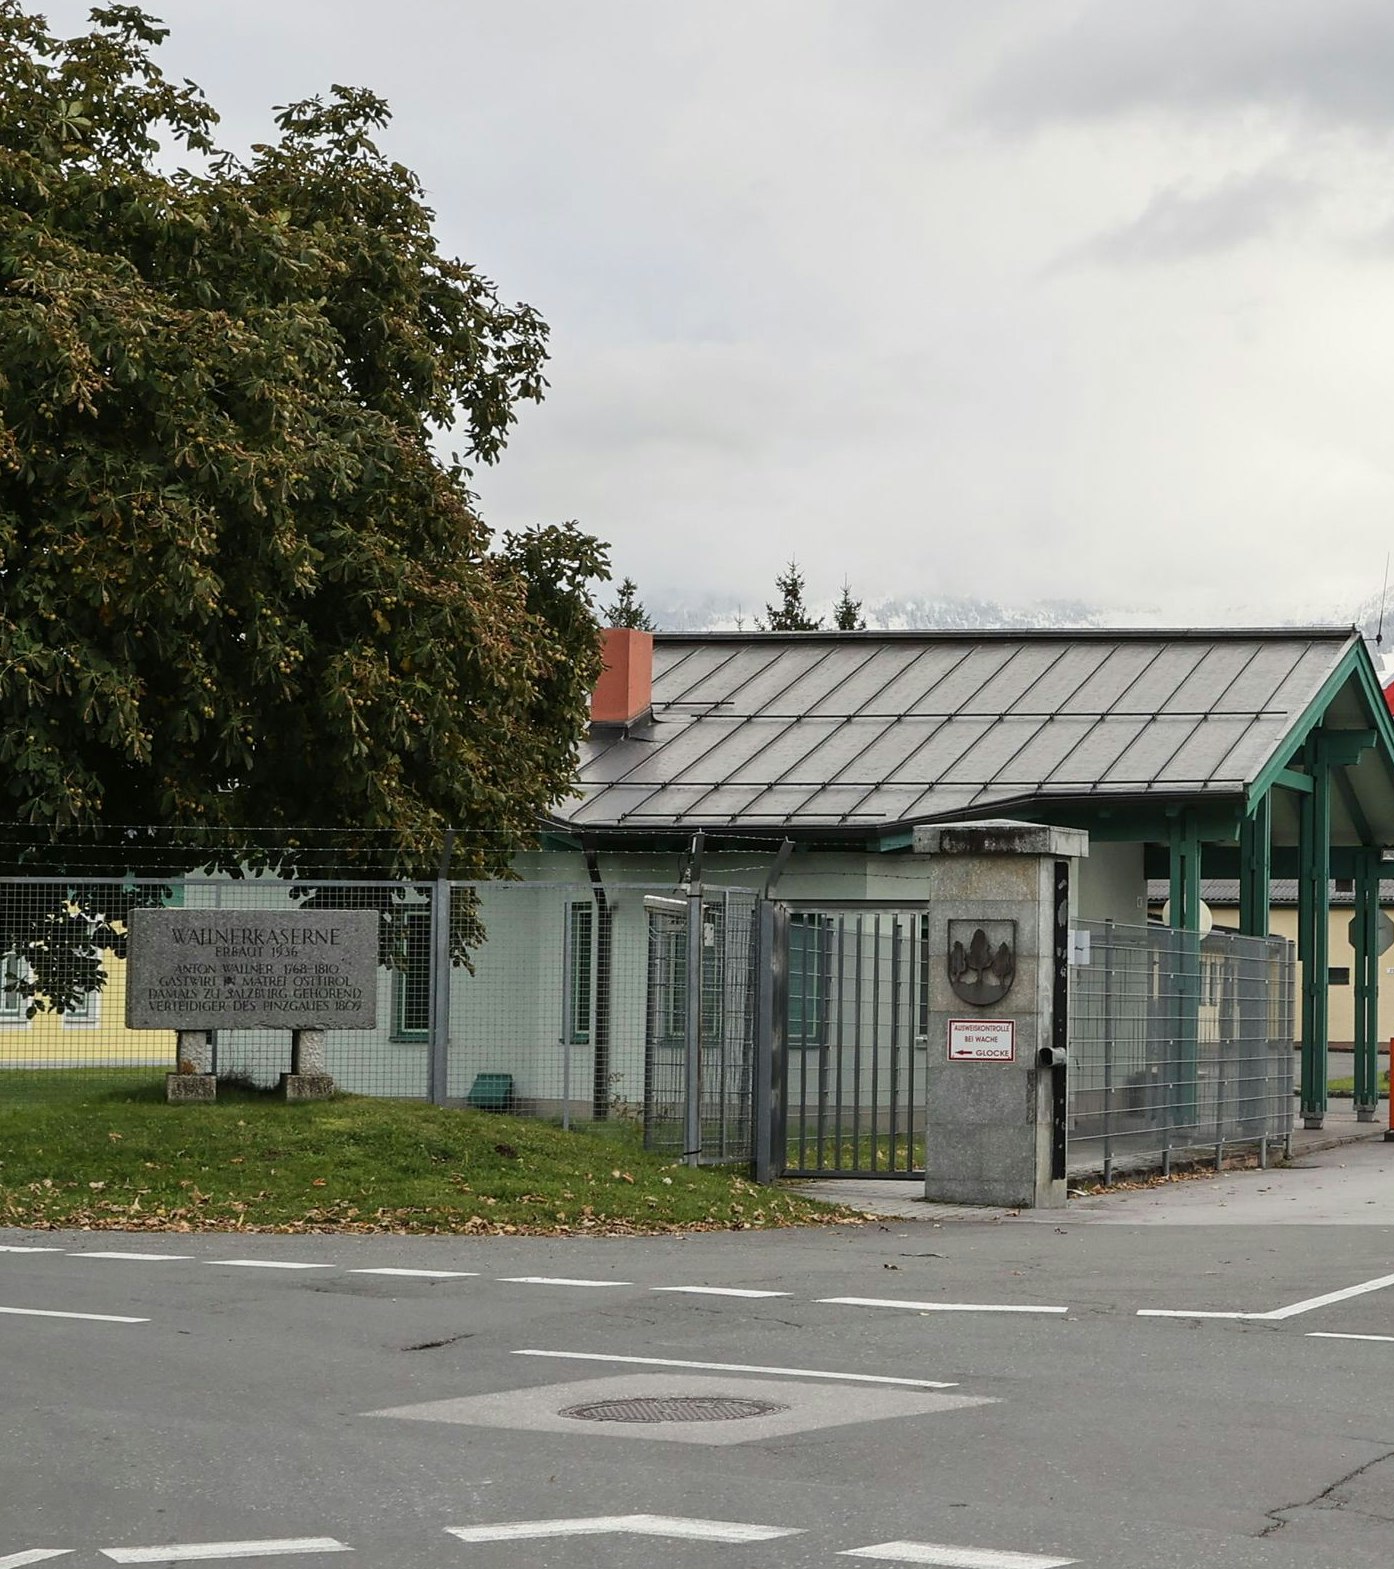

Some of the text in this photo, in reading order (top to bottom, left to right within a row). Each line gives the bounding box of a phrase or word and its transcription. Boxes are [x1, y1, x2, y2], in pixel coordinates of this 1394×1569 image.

[172, 928, 341, 946] WALLNERKASERNE
[215, 946, 298, 958] ERBAUT 1936
[174, 963, 216, 974] ANTON
[222, 963, 273, 975] WALLNER
[159, 975, 217, 987] GASTWIRT
[242, 975, 287, 987] MATREI
[293, 975, 351, 987] OSTTIROL
[149, 988, 198, 999] DAMALS
[203, 988, 220, 999] ZU
[225, 988, 287, 999] SALZBURG
[149, 1000, 361, 1012] VERTEIDIGER DES PINZGAUES 1809
[954, 1024, 1010, 1032] AUSWEISKONTROLLE
[975, 1035, 998, 1043] WACHE
[975, 1049, 1009, 1057] GLOCKE
